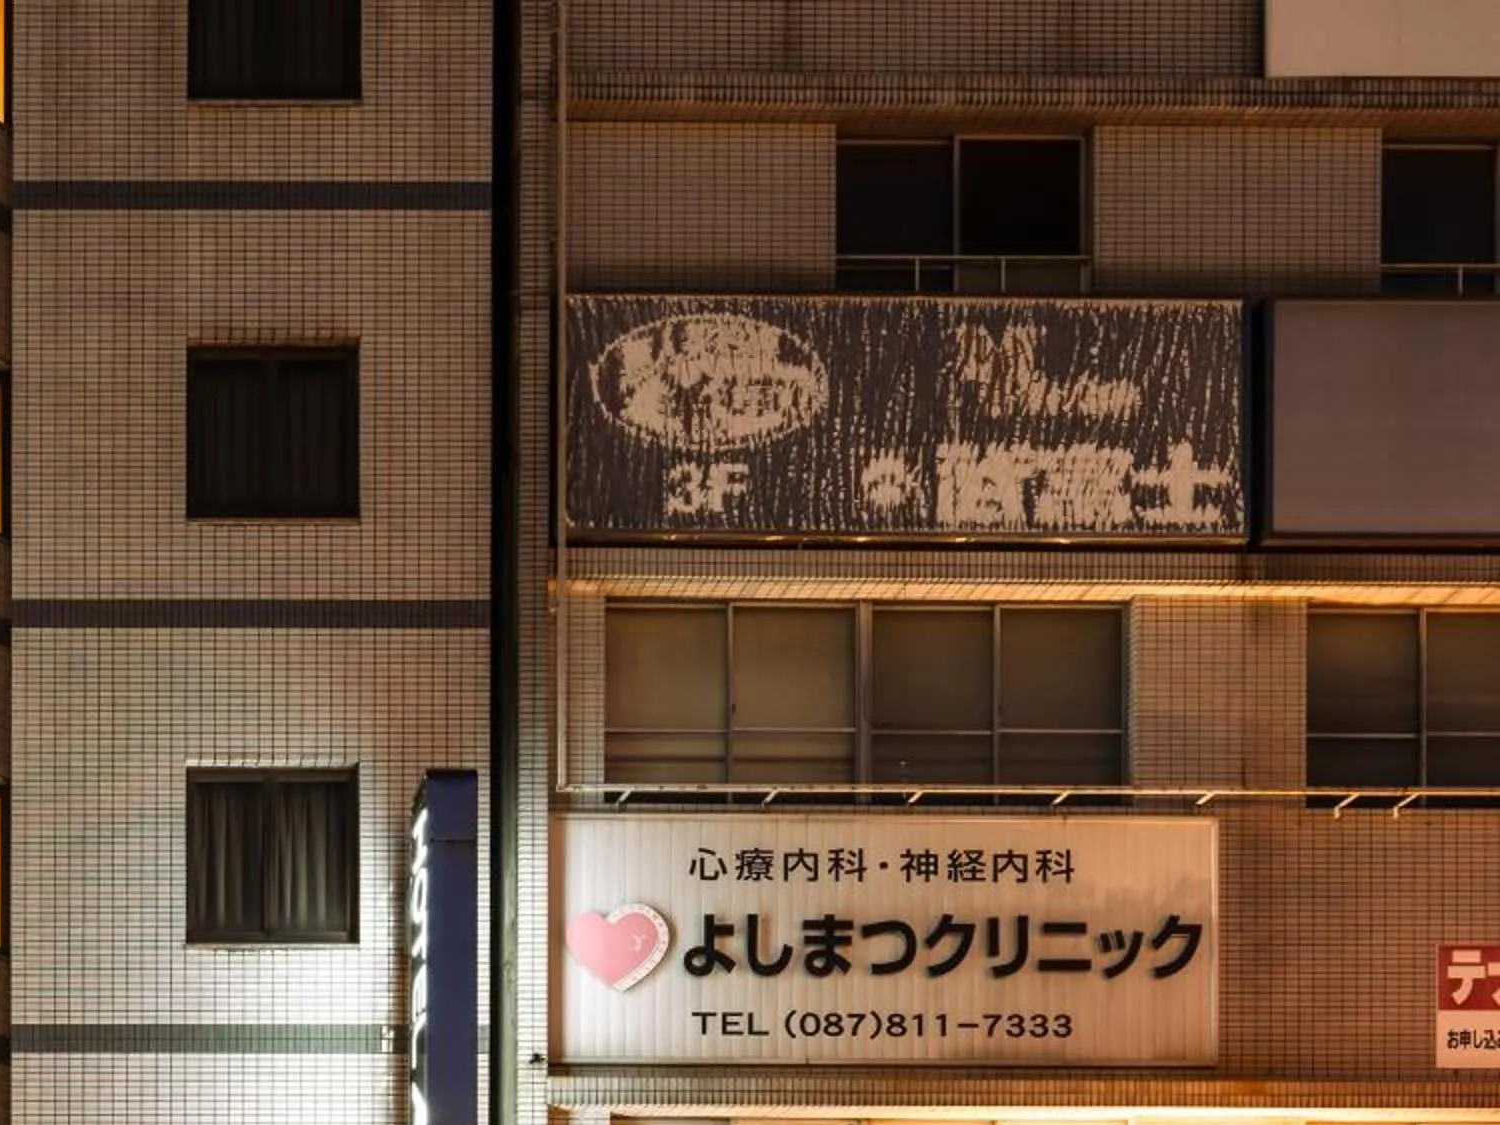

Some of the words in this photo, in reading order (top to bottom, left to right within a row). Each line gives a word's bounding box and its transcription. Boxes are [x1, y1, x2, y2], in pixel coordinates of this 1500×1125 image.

[689, 848, 1075, 884] 心療内科・神経内科
[683, 914, 1203, 979] よしまつクリニック
[691, 1012, 769, 1036] TEL
